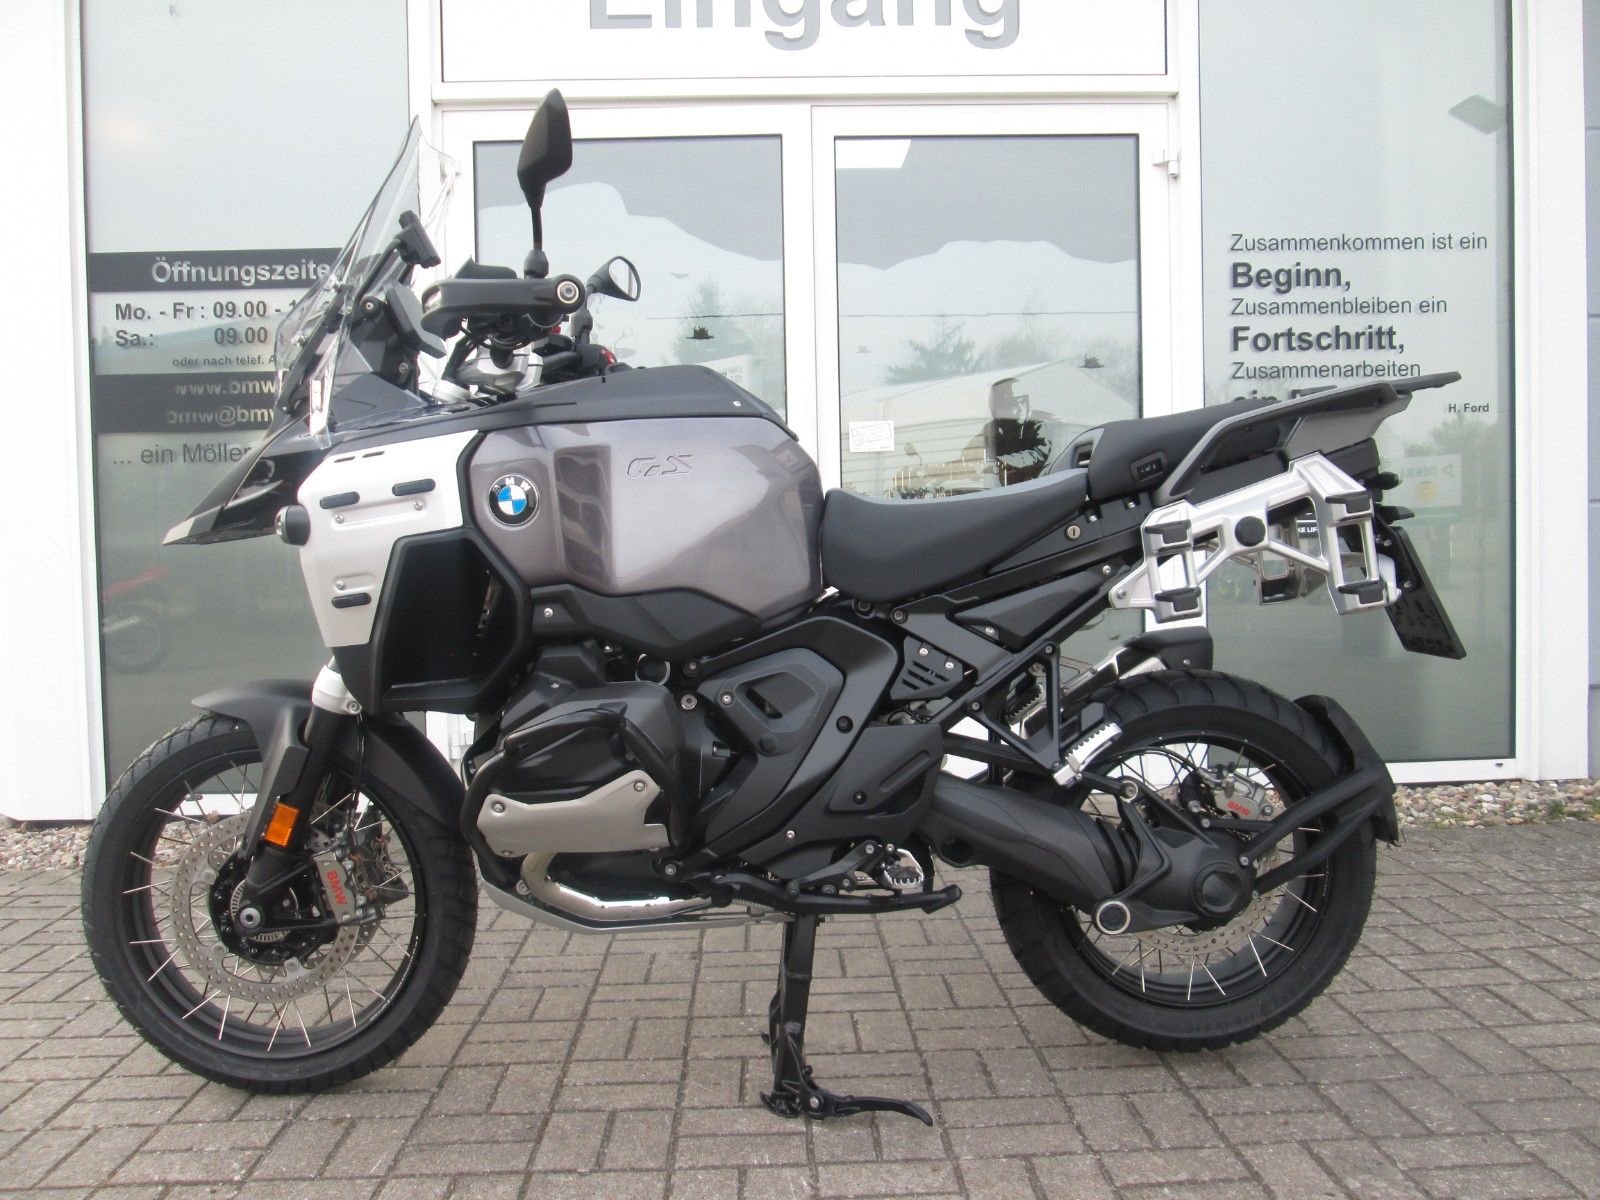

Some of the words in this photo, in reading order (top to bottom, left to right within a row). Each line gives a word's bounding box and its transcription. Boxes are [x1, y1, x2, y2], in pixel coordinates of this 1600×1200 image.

[1230, 233, 1424, 252] Zusammenkommen
[1431, 233, 1453, 250] ist
[1459, 232, 1488, 250] ein
[152, 257, 331, 286] Öffnungszeite
[1231, 262, 1351, 294] Beginn,
[115, 303, 151, 320] Mo.
[173, 302, 194, 319] Fr
[213, 301, 267, 318] 09.00
[1231, 297, 1412, 316] Zusammenbleiben
[1419, 296, 1448, 314] ein
[214, 327, 268, 345] 09.00
[1231, 325, 1404, 354] Fortschritt,
[172, 358, 199, 367] oder
[203, 356, 232, 366] nach
[236, 355, 264, 365] telef.
[1231, 360, 1421, 379] Zusammenarbeiten
[1448, 403, 1461, 413] H.
[1463, 403, 1490, 413] Ford
[140, 445, 174, 464] ein
[626, 454, 693, 478] GS
[493, 476, 532, 494] BMW
[1227, 801, 1252, 816] BMW
[328, 869, 347, 905] BMW
